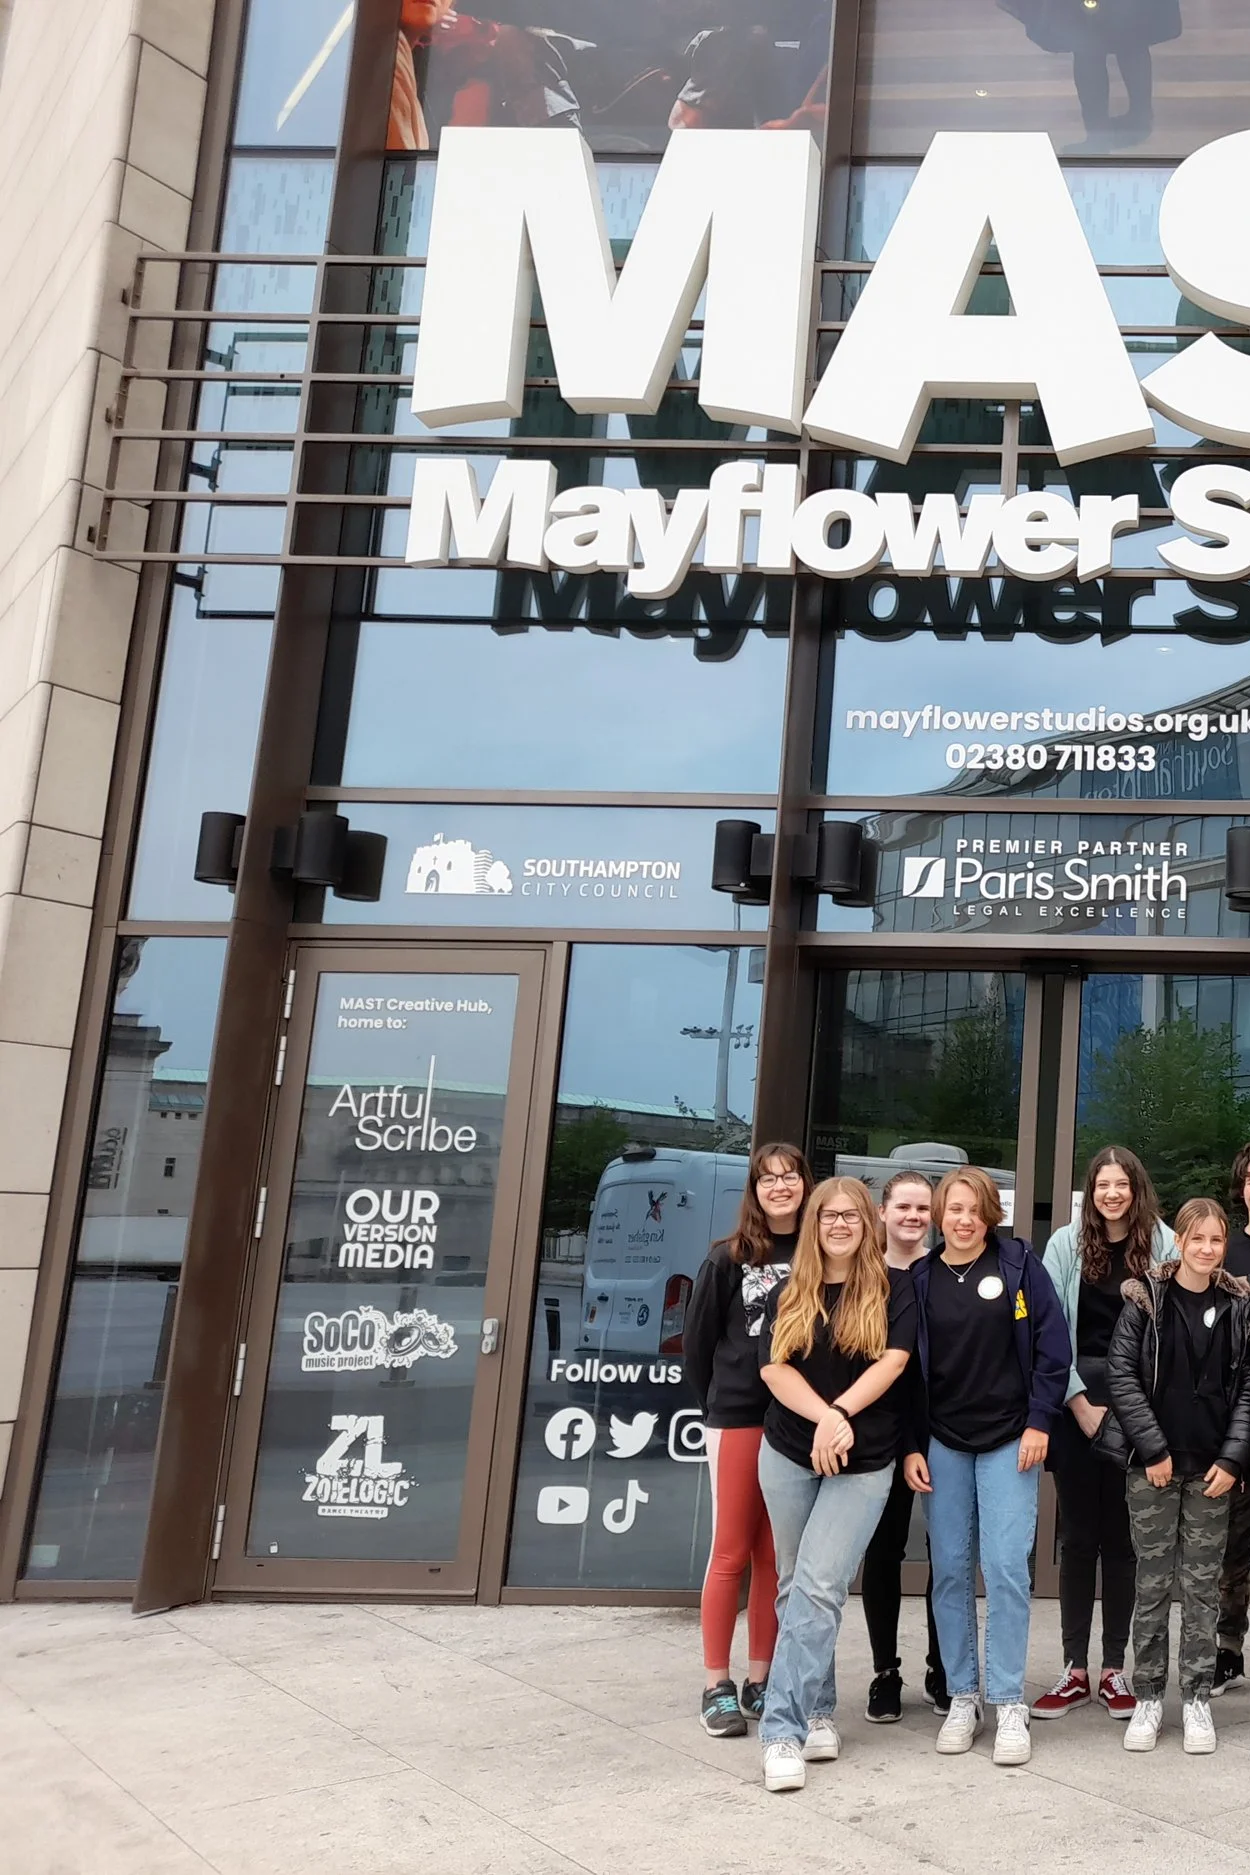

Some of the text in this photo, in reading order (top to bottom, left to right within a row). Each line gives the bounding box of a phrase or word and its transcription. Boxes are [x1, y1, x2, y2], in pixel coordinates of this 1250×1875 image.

[405, 458, 1139, 599] Mayflower
[945, 743, 1048, 770] 02380
[1054, 745, 1157, 771] 711833
[956, 839, 1188, 857] PREMIER PARTNER
[523, 859, 681, 880] SOUTHAMPTON
[953, 857, 1188, 902] Paris Smith
[521, 882, 678, 899] CITY COUNCIL
[953, 905, 1187, 919] LEGAL EXCELLENCE
[340, 997, 493, 1015] MAST Creative Hub,
[337, 1015, 407, 1029] home to:
[328, 1055, 436, 1119] Artful
[345, 1188, 440, 1224] OUR
[343, 1223, 438, 1243] VERSION
[338, 1243, 434, 1269] MEDIA
[306, 1313, 377, 1354] SoCo
[305, 1354, 374, 1369] music project
[550, 1358, 682, 1384] Follow us
